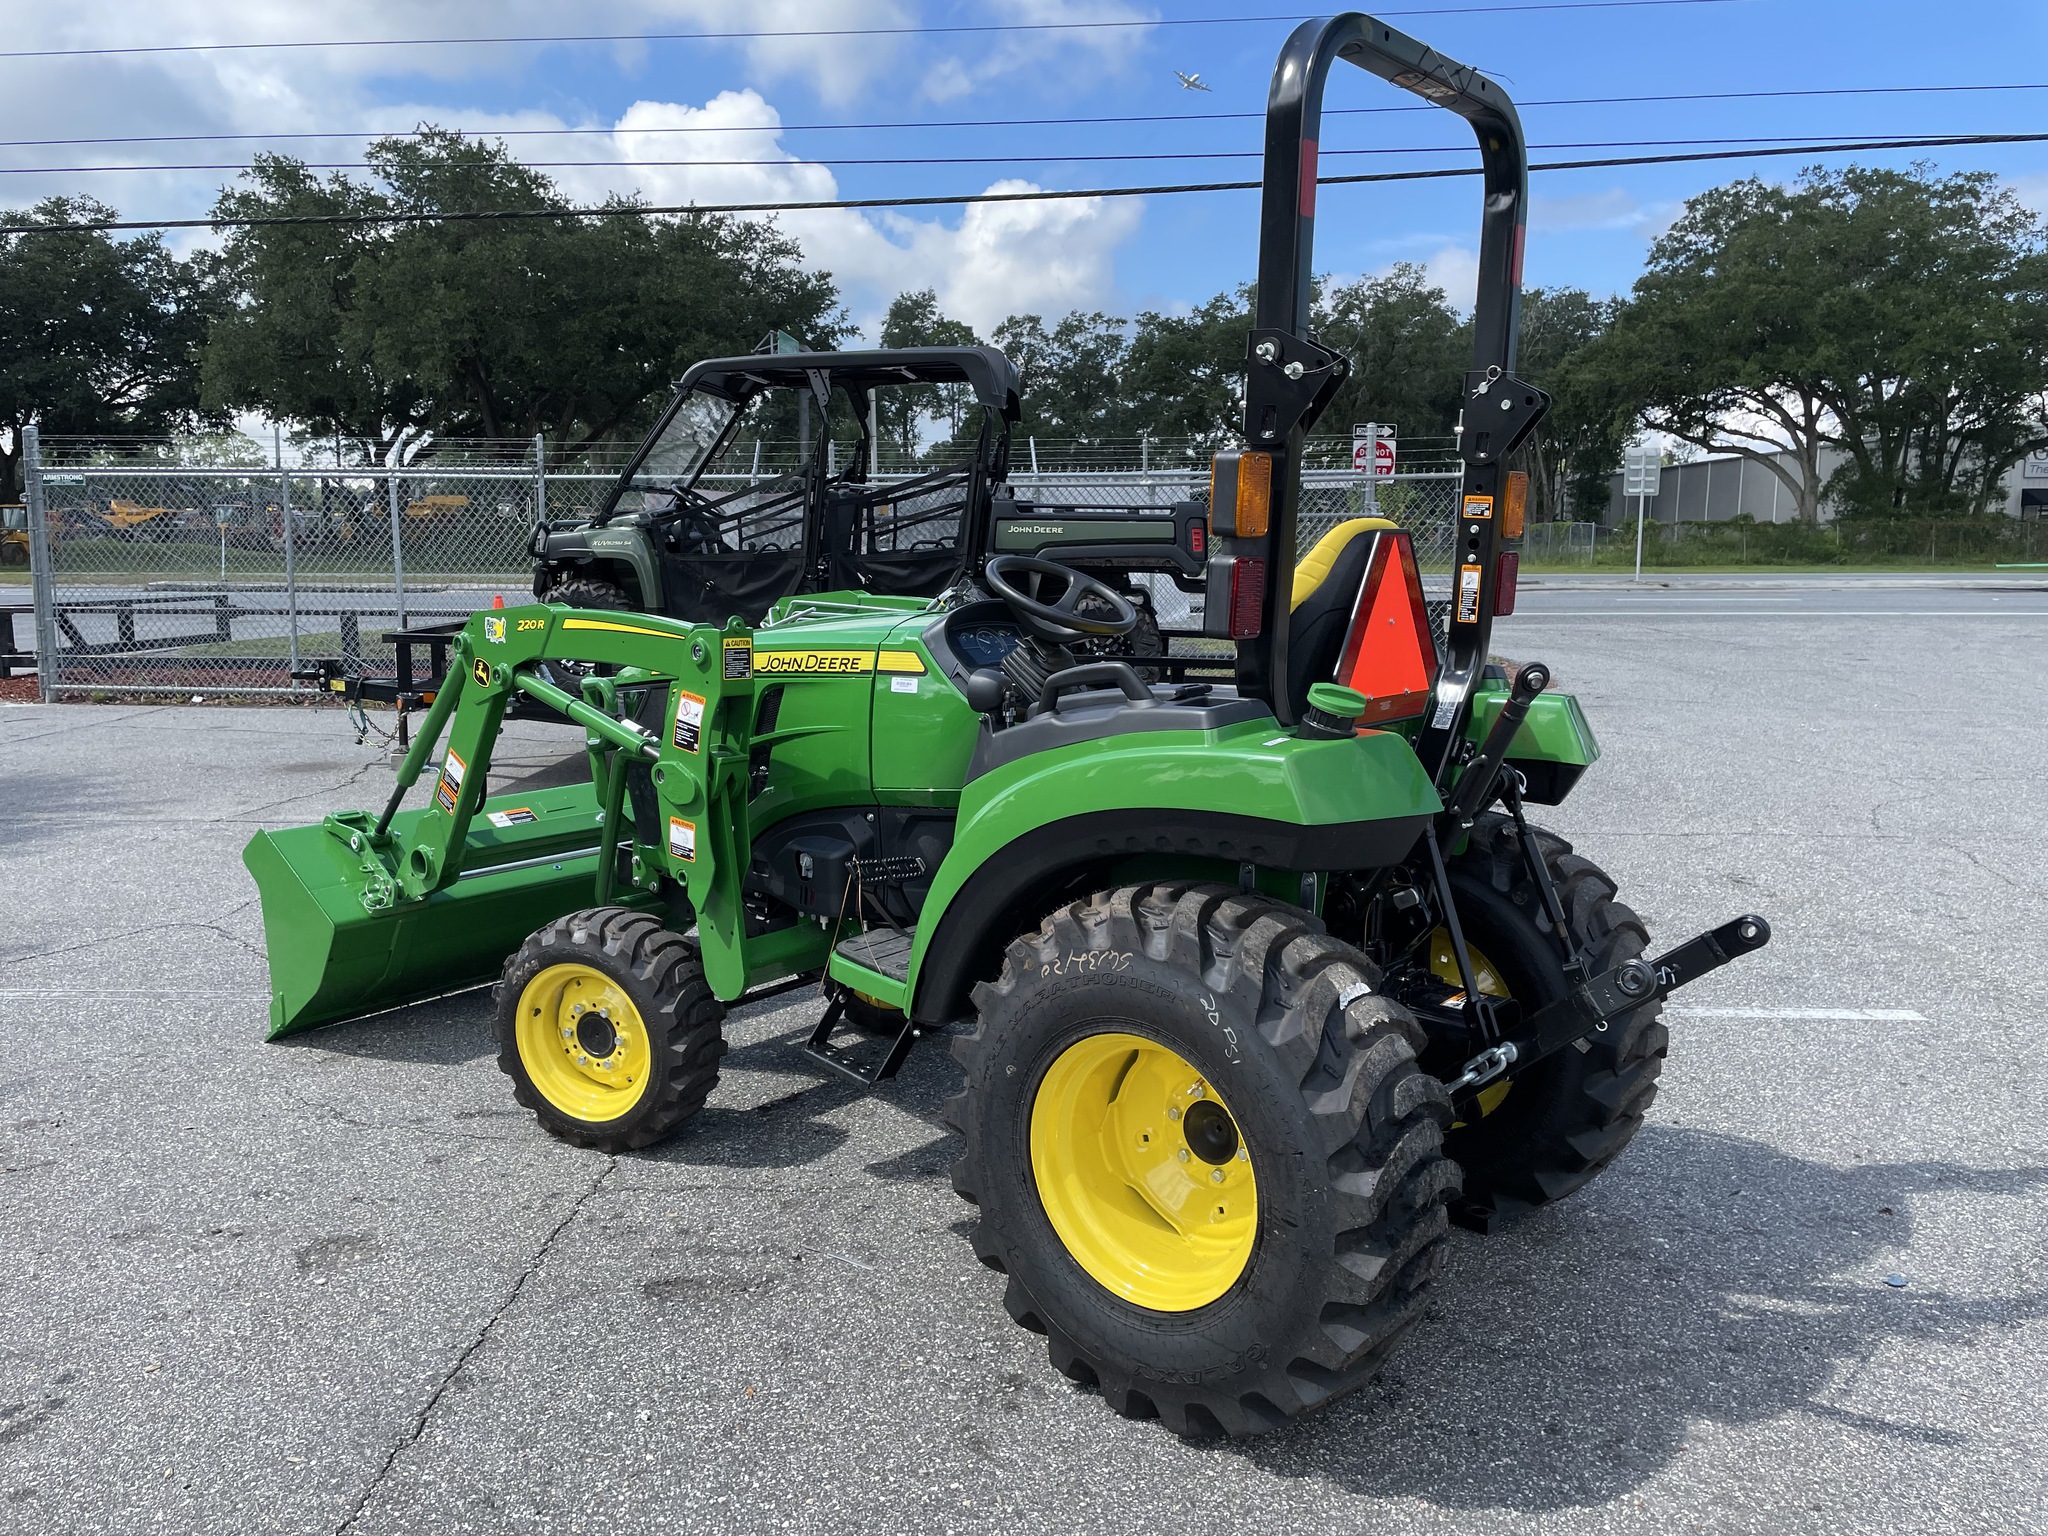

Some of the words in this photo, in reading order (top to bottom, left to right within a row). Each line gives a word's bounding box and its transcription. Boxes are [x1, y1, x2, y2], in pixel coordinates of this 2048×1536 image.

[1007, 525, 1032, 533] JOHN
[1033, 525, 1064, 534] DEERE
[731, 639, 751, 647] CAUTION
[761, 654, 804, 671] JOHN
[804, 655, 862, 671] DEERE
[1009, 971, 1178, 1031] MARATHONER
